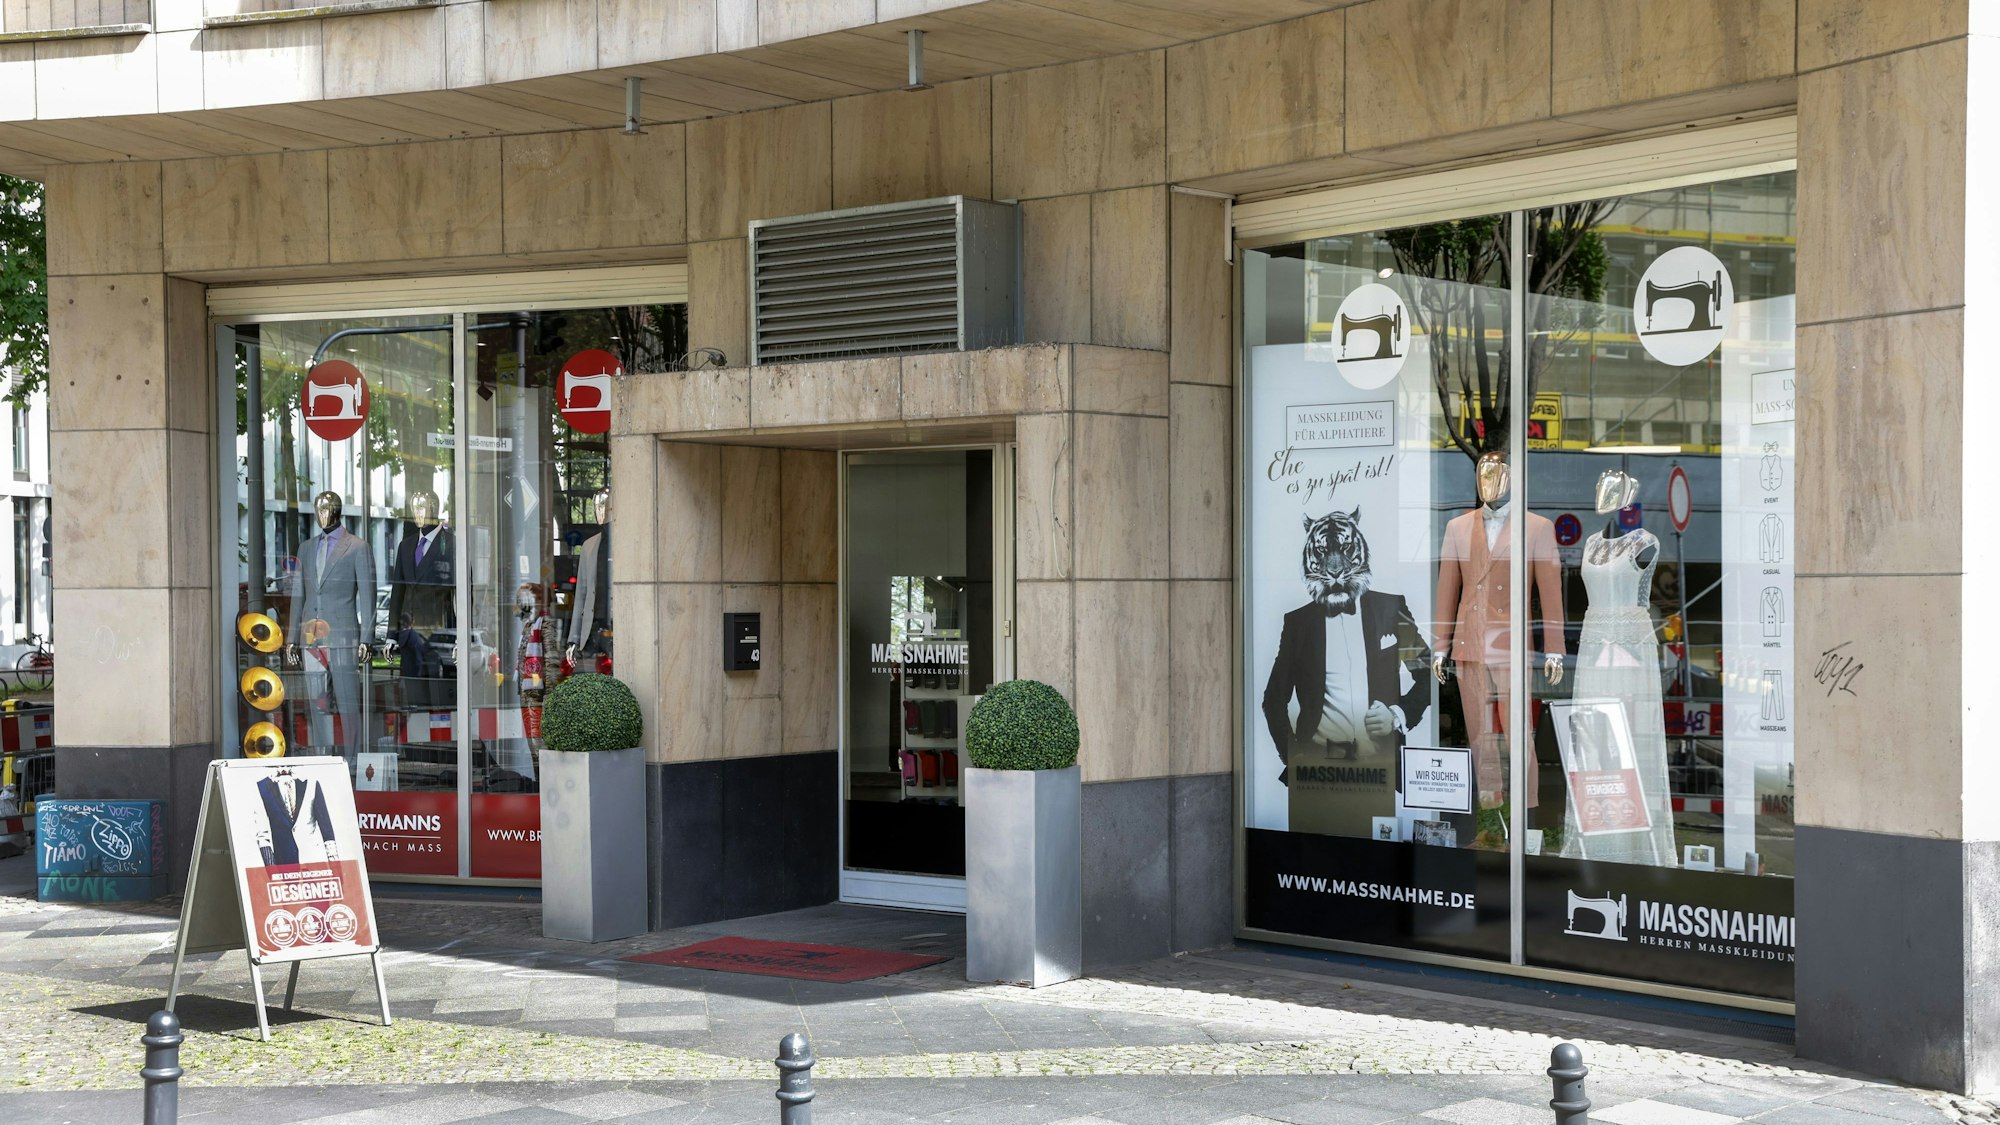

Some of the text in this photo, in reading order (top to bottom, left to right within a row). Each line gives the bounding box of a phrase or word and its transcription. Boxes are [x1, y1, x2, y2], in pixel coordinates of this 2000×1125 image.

[1297, 409, 1383, 424] MASSKLEIDUNG
[1295, 426, 1386, 441] FÜR ALPHATIERE
[1267, 445, 1304, 482] Ehe
[750, 648, 760, 662] 43
[871, 643, 969, 664] MASSNAHME
[1296, 765, 1387, 785] MASSNAHME
[1415, 770, 1459, 782] WIR SUCHEN
[358, 813, 441, 832] RTMANNS
[363, 841, 442, 853] NACH MASS
[270, 880, 340, 902] DESIGNER
[1277, 873, 1475, 910] WWW.MASSNAHME.DE
[1639, 935, 1692, 949] HERREN
